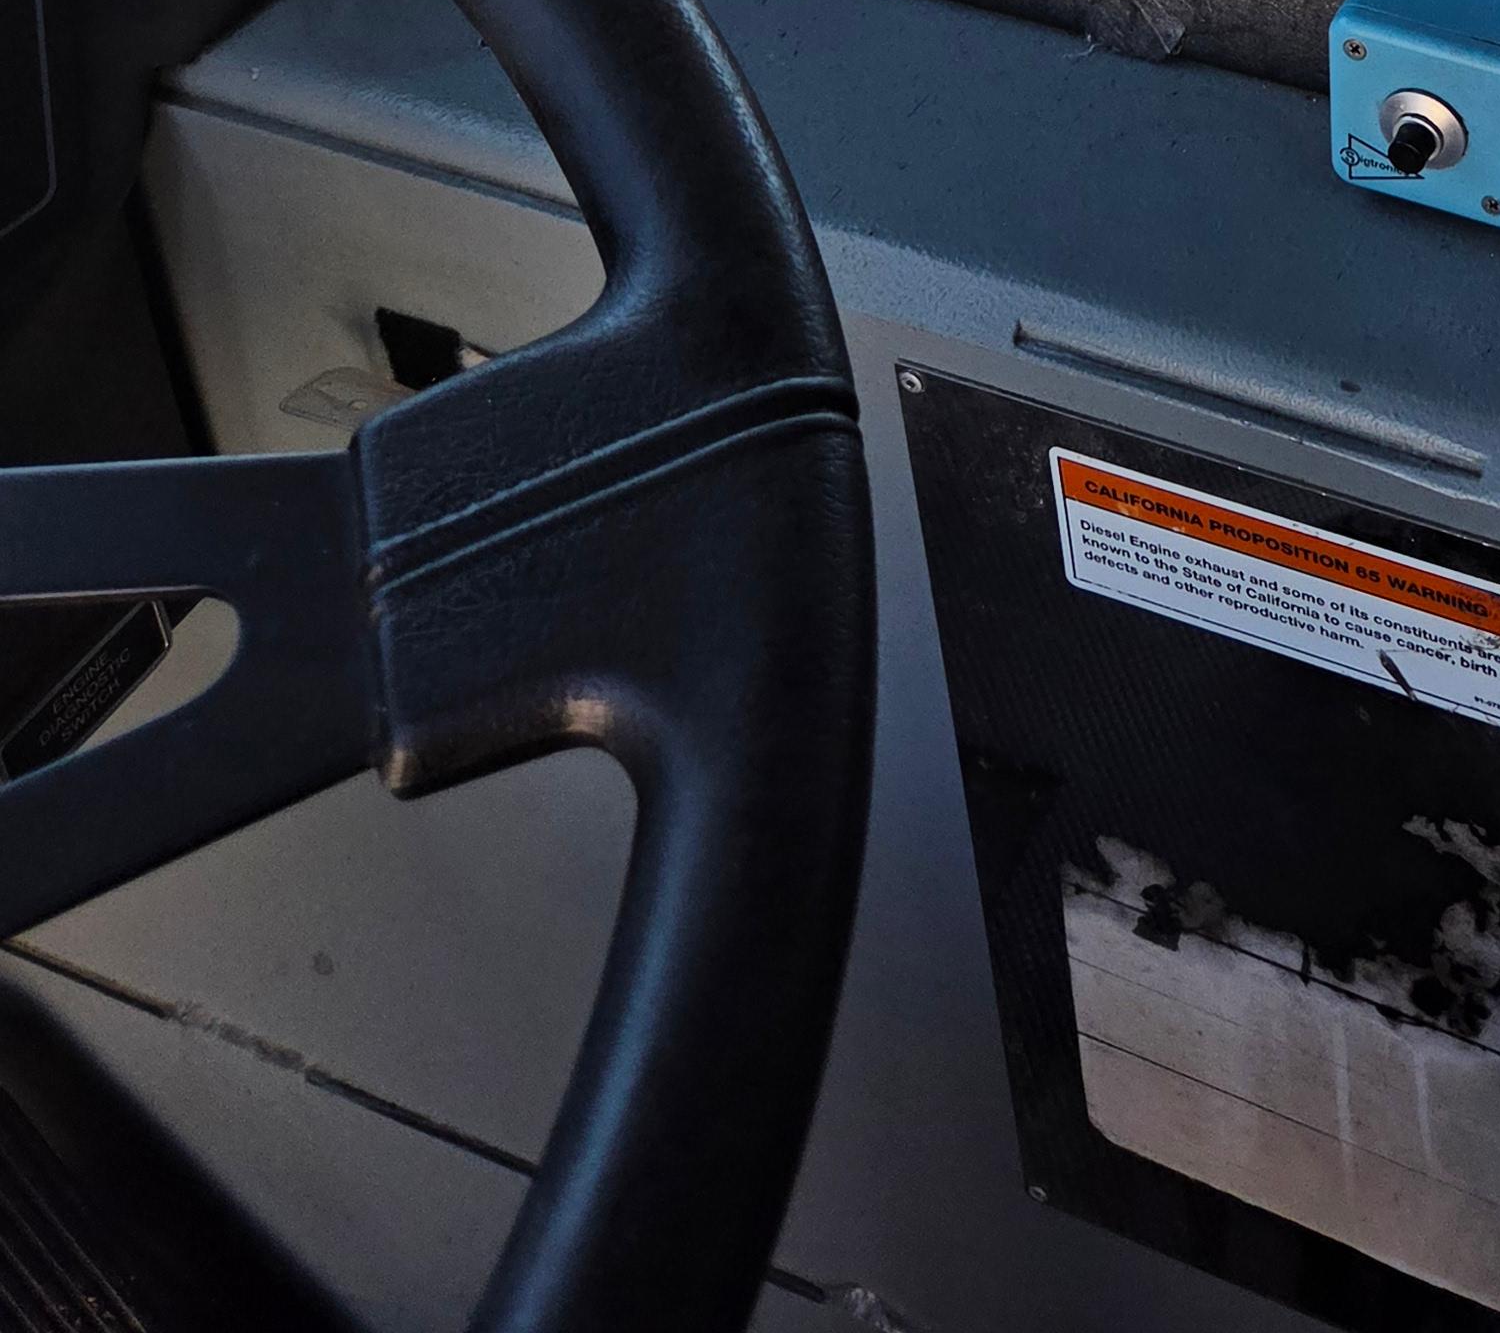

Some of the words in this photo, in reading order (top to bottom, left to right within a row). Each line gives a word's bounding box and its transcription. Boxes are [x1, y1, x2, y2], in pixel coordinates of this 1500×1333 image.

[1080, 519, 1125, 543] Diesel
[1129, 535, 1181, 561] Engine
[1185, 554, 1245, 582] exhaust
[1249, 573, 1278, 592] and
[1282, 585, 1326, 607] some
[1331, 597, 1345, 614] of
[1349, 604, 1370, 621] its
[1373, 613, 1473, 655] constituents
[1084, 479, 1204, 529] CALIFORNIA
[1208, 518, 1350, 574] PROPOSITION
[1355, 565, 1381, 584] 65
[1387, 574, 1490, 619] WARNING
[1084, 549, 1139, 577] defects
[1143, 569, 1170, 586] and
[1174, 580, 1215, 601] other
[1218, 594, 1316, 634] reproductive
[1319, 623, 1365, 651] harm.
[1082, 534, 1131, 560] known
[1135, 550, 1150, 566] to
[1154, 556, 1179, 575] the
[1182, 566, 1223, 589] State
[1227, 580, 1242, 596] of
[1245, 587, 1320, 621] California
[1324, 611, 1340, 627] to
[1345, 620, 1392, 644] cause
[1396, 635, 1456, 666] cancer,
[1460, 654, 1498, 679] birth
[39, 647, 130, 746] DIAGNOSTIC
[53, 651, 108, 714] ENGINE
[61, 677, 121, 742] SWITCH
